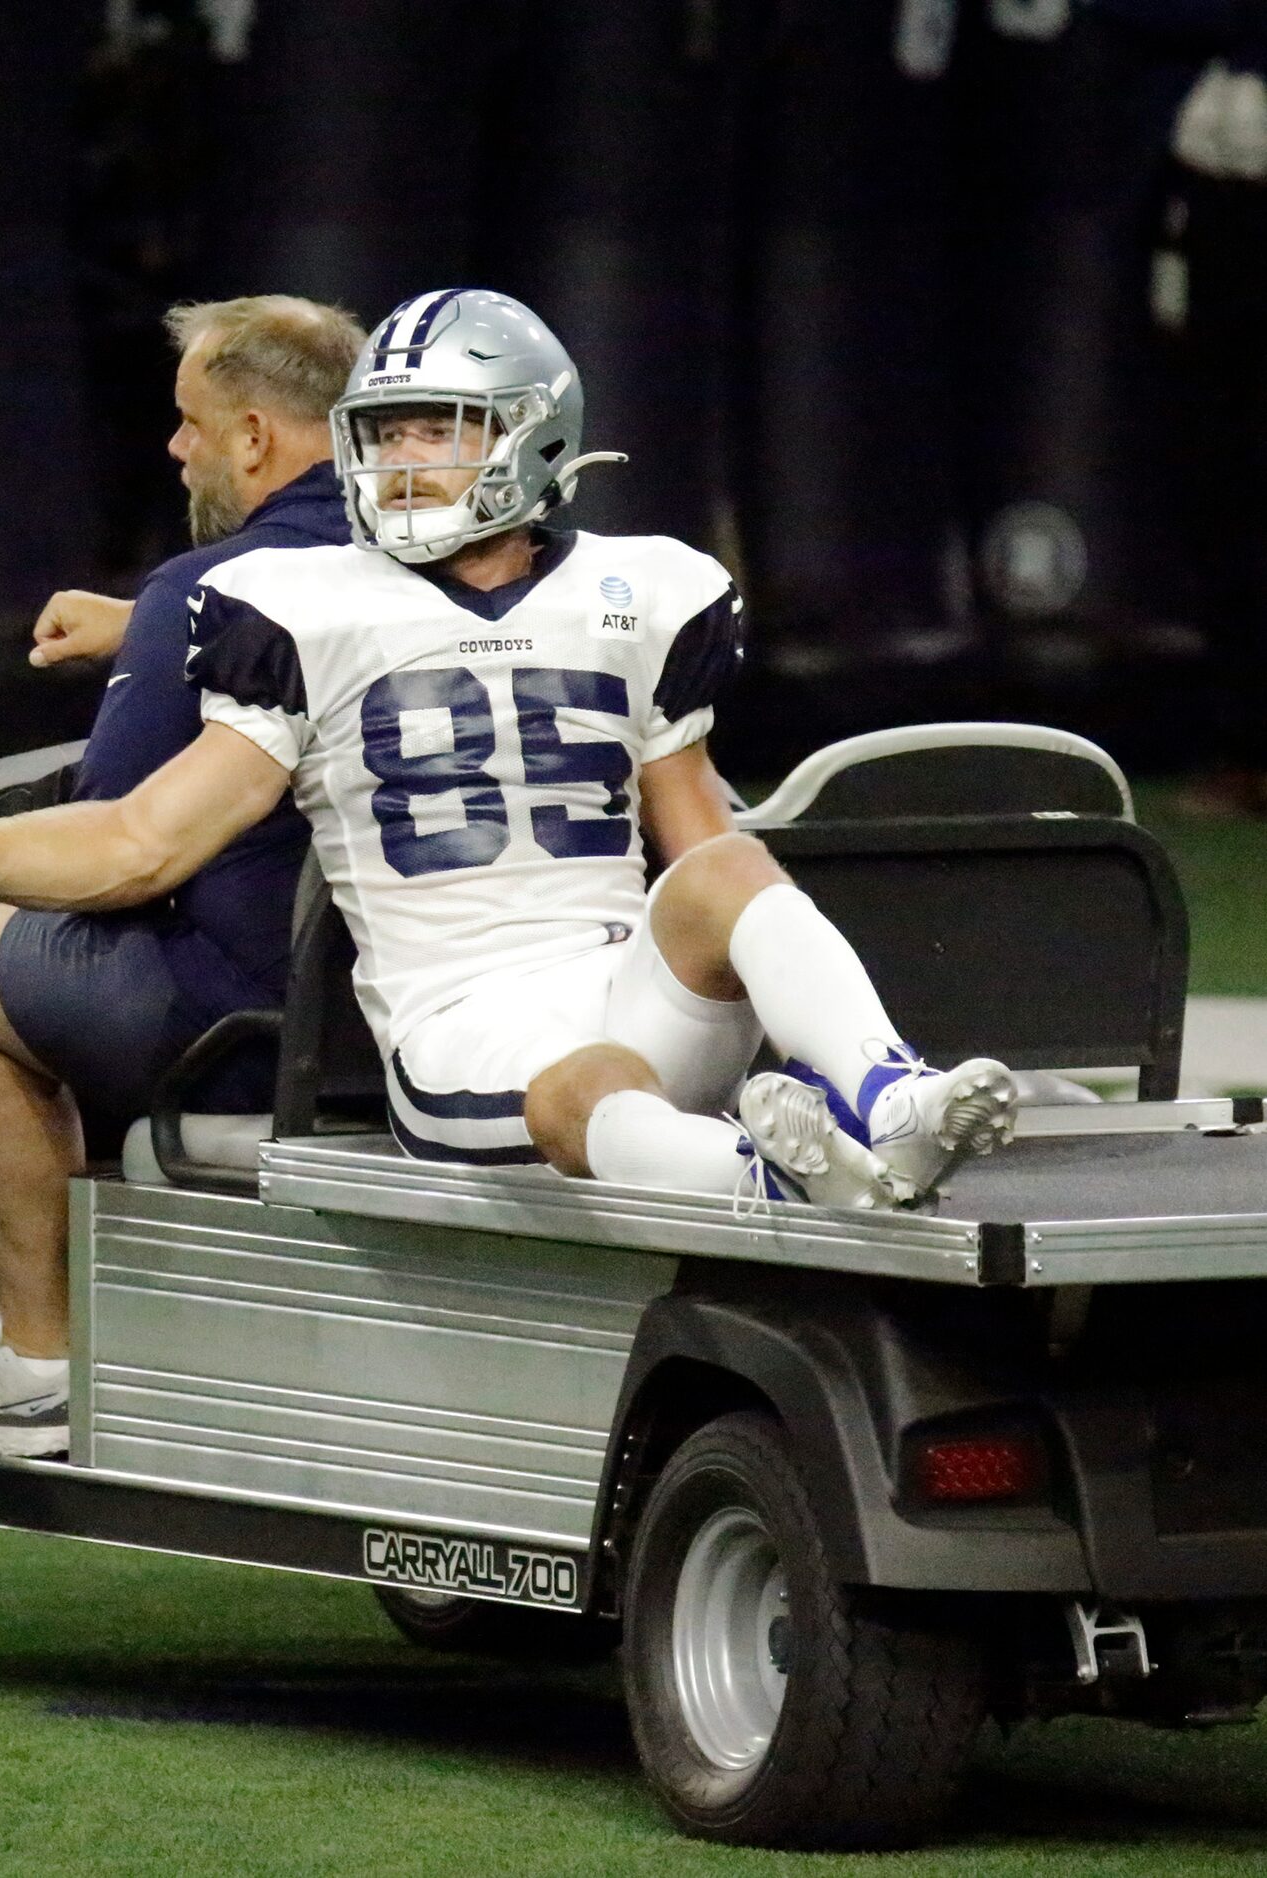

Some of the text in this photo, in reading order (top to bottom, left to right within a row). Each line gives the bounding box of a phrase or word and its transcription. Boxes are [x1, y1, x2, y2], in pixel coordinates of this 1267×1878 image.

[459, 638, 533, 654] COWBOYS
[601, 613, 638, 632] AT&T
[361, 666, 633, 879] 85
[363, 1528, 577, 1604] CARRYALL 700
